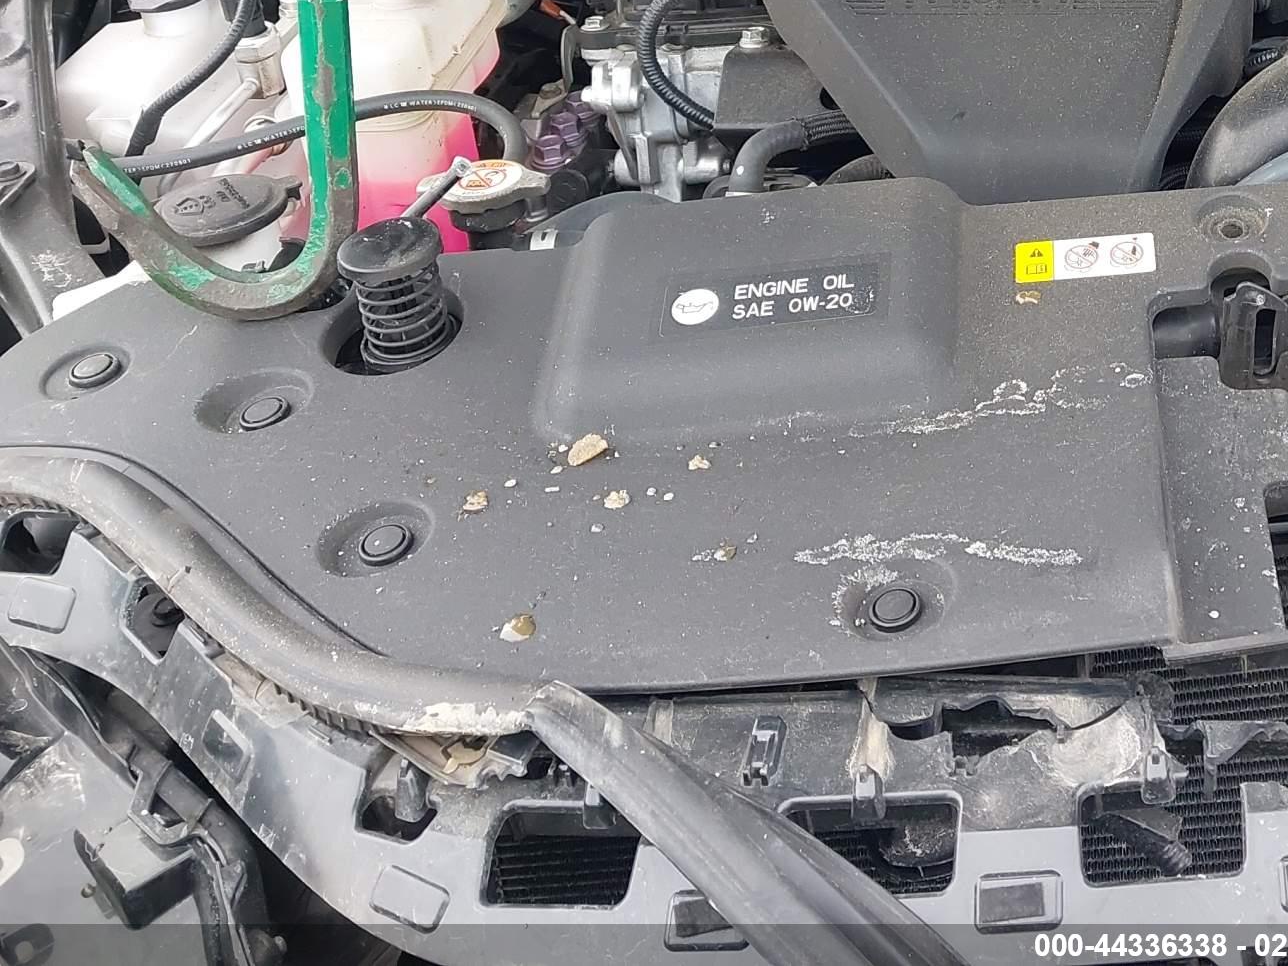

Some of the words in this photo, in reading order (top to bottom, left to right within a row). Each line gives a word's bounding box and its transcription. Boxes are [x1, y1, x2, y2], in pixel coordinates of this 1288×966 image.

[734, 278, 809, 300] ENGINE
[823, 274, 855, 290] OIL
[732, 300, 775, 320] SAE
